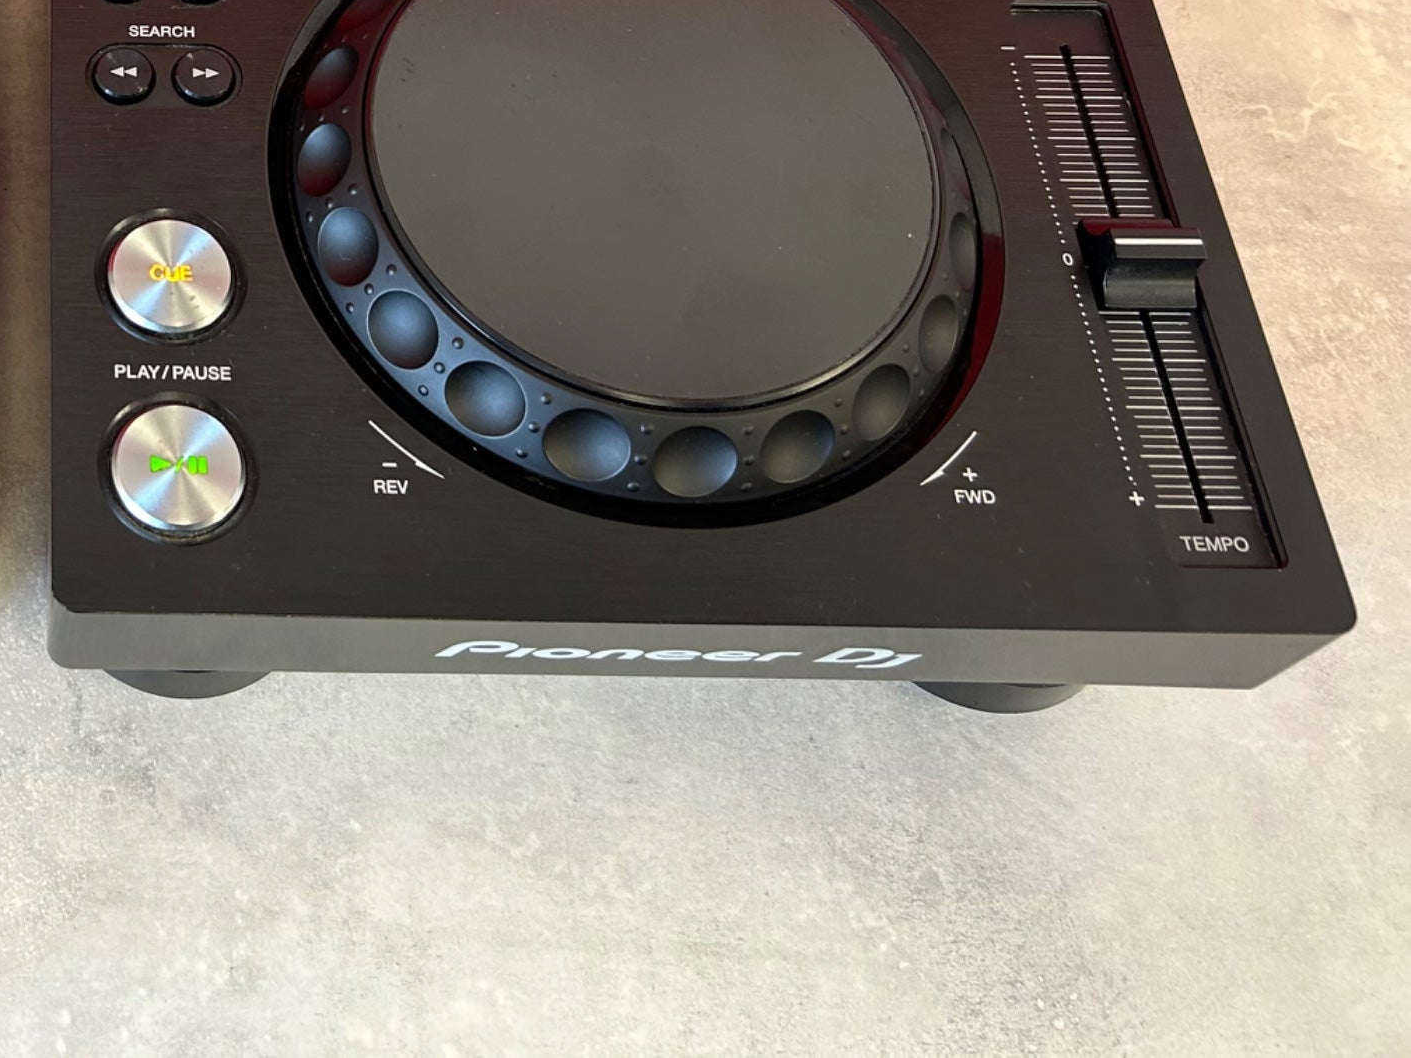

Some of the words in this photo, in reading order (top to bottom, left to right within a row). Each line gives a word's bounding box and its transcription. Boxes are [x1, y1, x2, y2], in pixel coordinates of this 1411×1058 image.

[128, 25, 195, 38] SEARCH
[1062, 252, 1074, 266] 0
[148, 264, 193, 282] CUE
[114, 364, 232, 381] PLAY/PAUSE
[374, 479, 409, 494] REV
[954, 489, 997, 504] FWD
[1180, 535, 1250, 553] TEMPO
[434, 640, 803, 662] Pioneer
